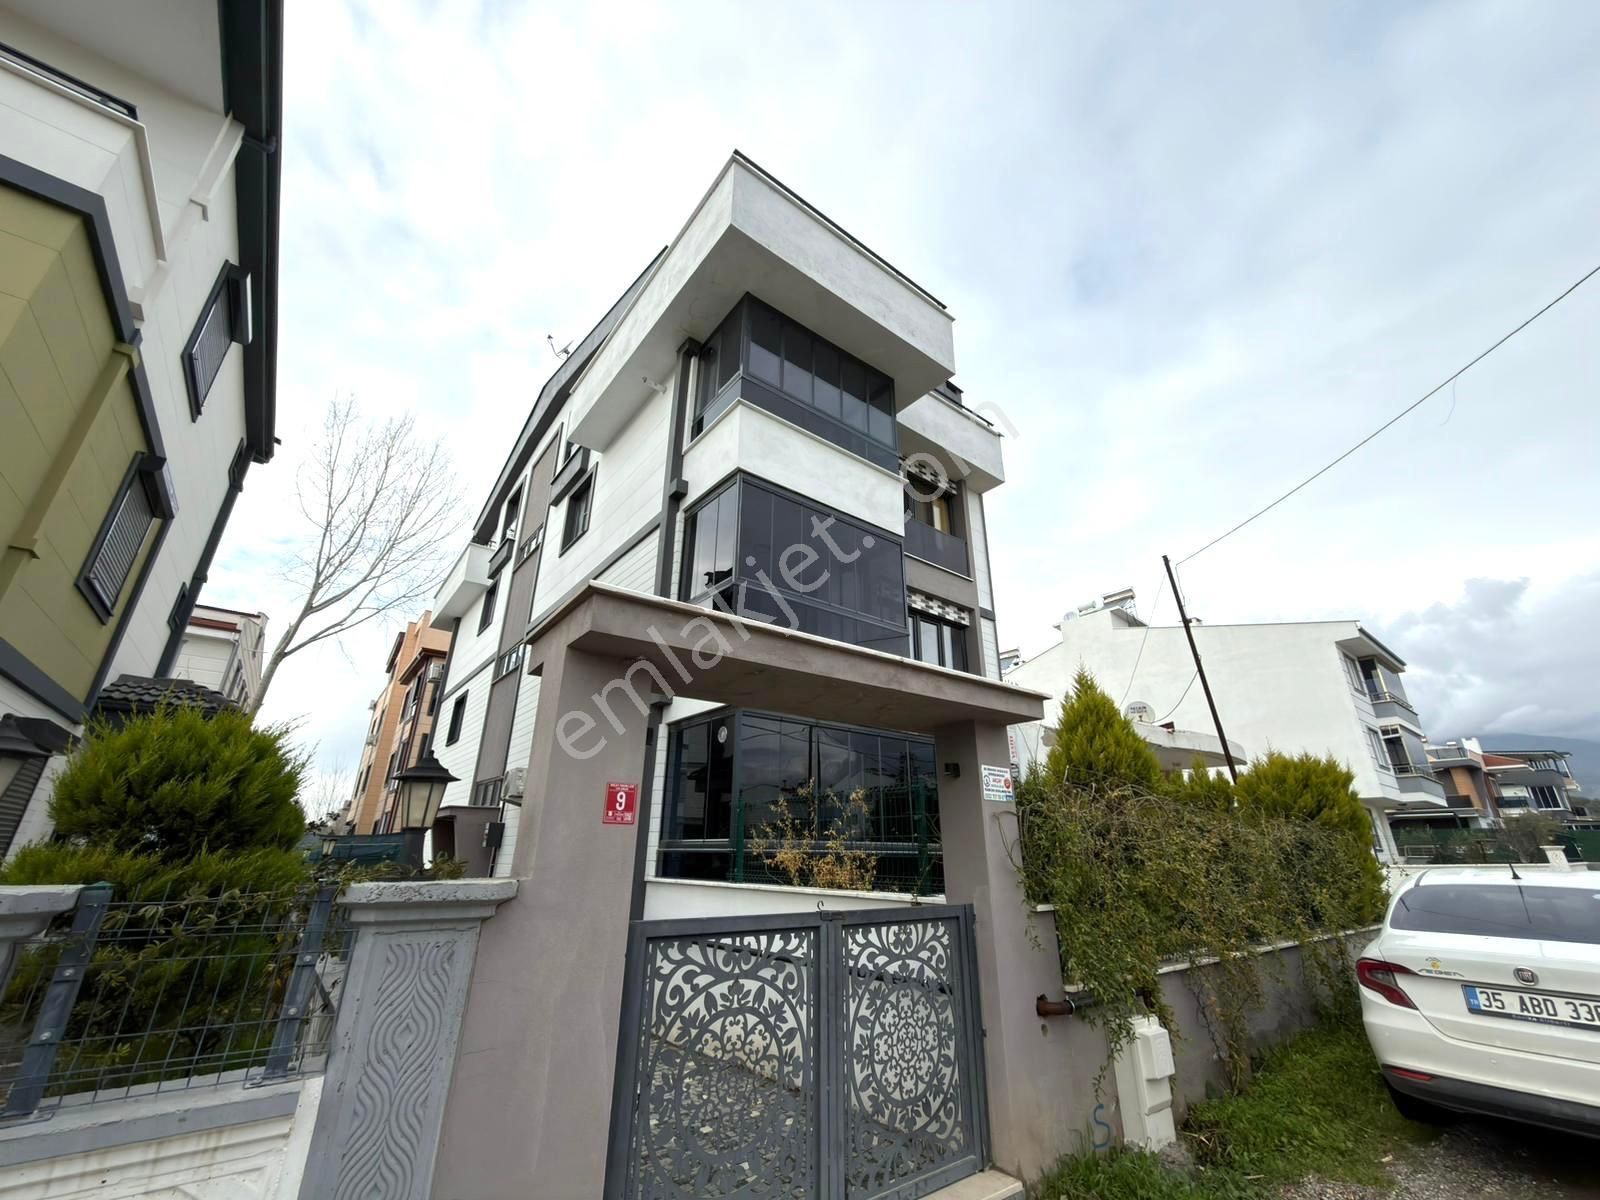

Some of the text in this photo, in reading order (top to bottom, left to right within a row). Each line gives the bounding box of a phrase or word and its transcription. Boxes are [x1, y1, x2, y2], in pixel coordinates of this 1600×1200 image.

[615, 791, 626, 811] 9
[1479, 990, 1506, 1010] 35
[1519, 995, 1558, 1017] ABD
